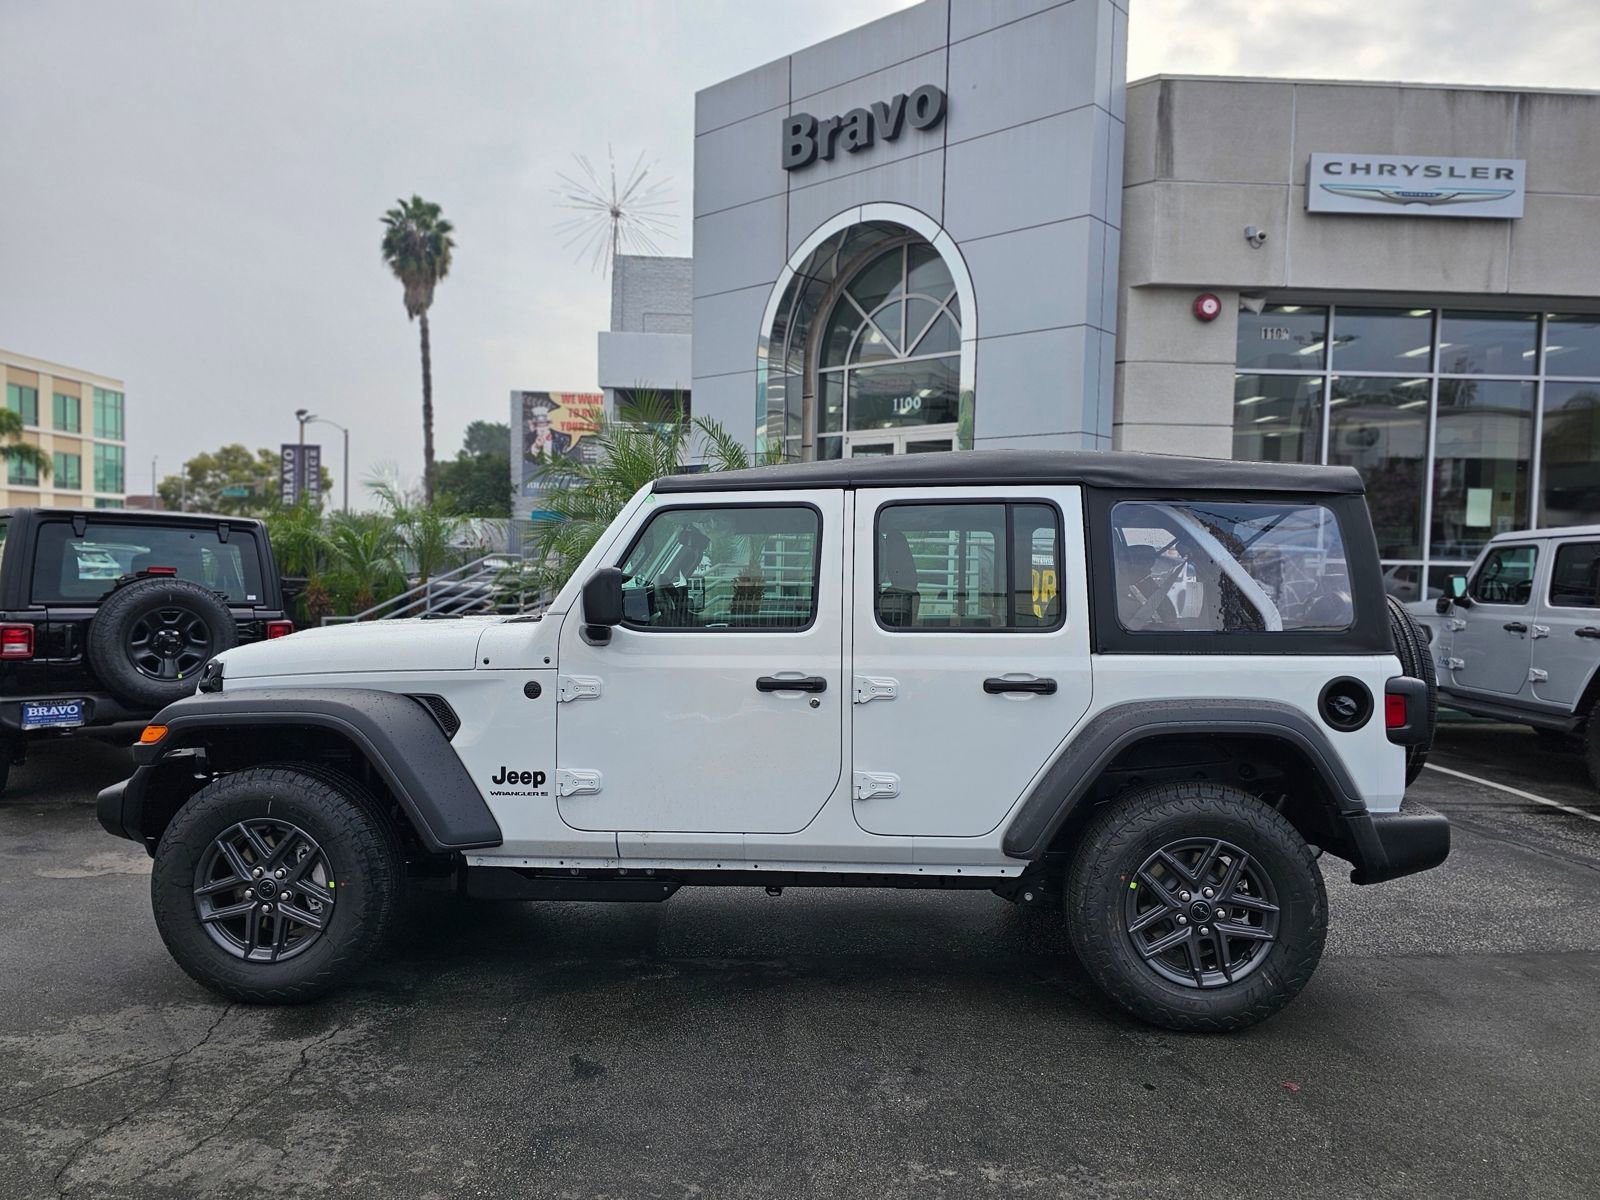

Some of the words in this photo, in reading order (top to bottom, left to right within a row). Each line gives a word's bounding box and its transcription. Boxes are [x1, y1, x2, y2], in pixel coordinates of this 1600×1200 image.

[782, 84, 948, 171] Bravo
[1323, 157, 1515, 181] CHRYSLER
[893, 396, 922, 412] 1100
[283, 449, 294, 505] BRAVO
[27, 705, 78, 716] BRAVO
[492, 766, 546, 788] Jeep
